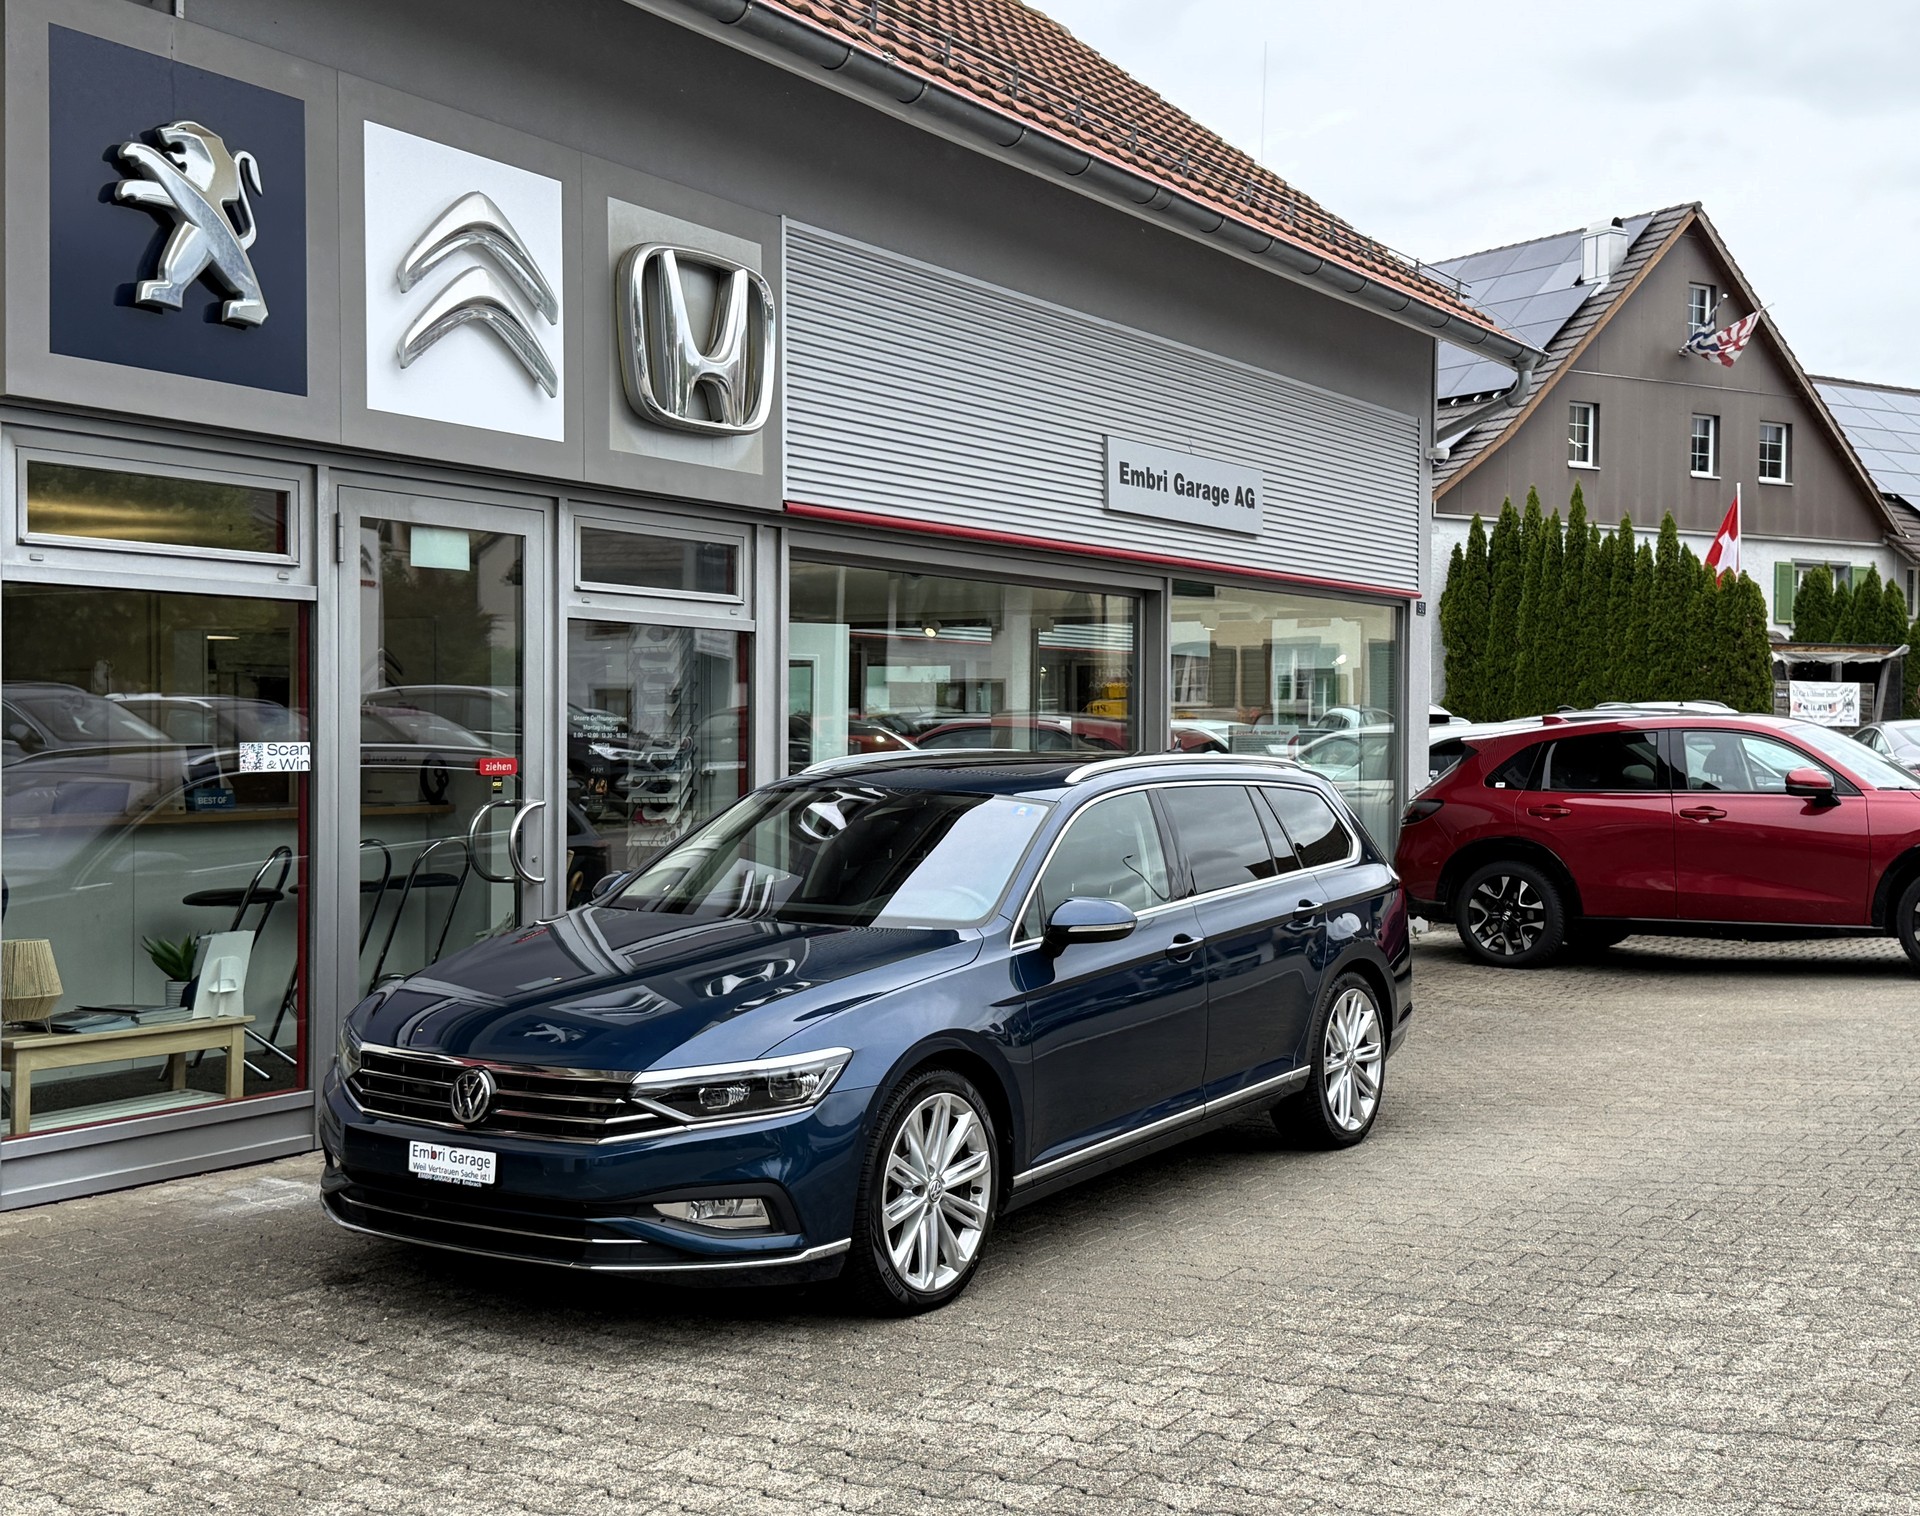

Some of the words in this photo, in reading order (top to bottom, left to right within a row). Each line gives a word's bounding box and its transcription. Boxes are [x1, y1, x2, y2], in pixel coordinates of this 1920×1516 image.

[1119, 461, 1168, 493] Embri
[1173, 472, 1230, 507] Garage
[1234, 485, 1256, 509] AG
[266, 743, 311, 756] Scan
[266, 760, 277, 770] &
[279, 757, 311, 770] Win
[485, 761, 512, 771] ziehen
[198, 796, 217, 805] BEST
[218, 796, 228, 804] OF
[412, 1144, 446, 1161] Embri
[448, 1150, 491, 1171] Garage
[412, 1162, 427, 1170] Weil
[428, 1164, 460, 1177] Vertrauen
[460, 1169, 479, 1180] Sache
